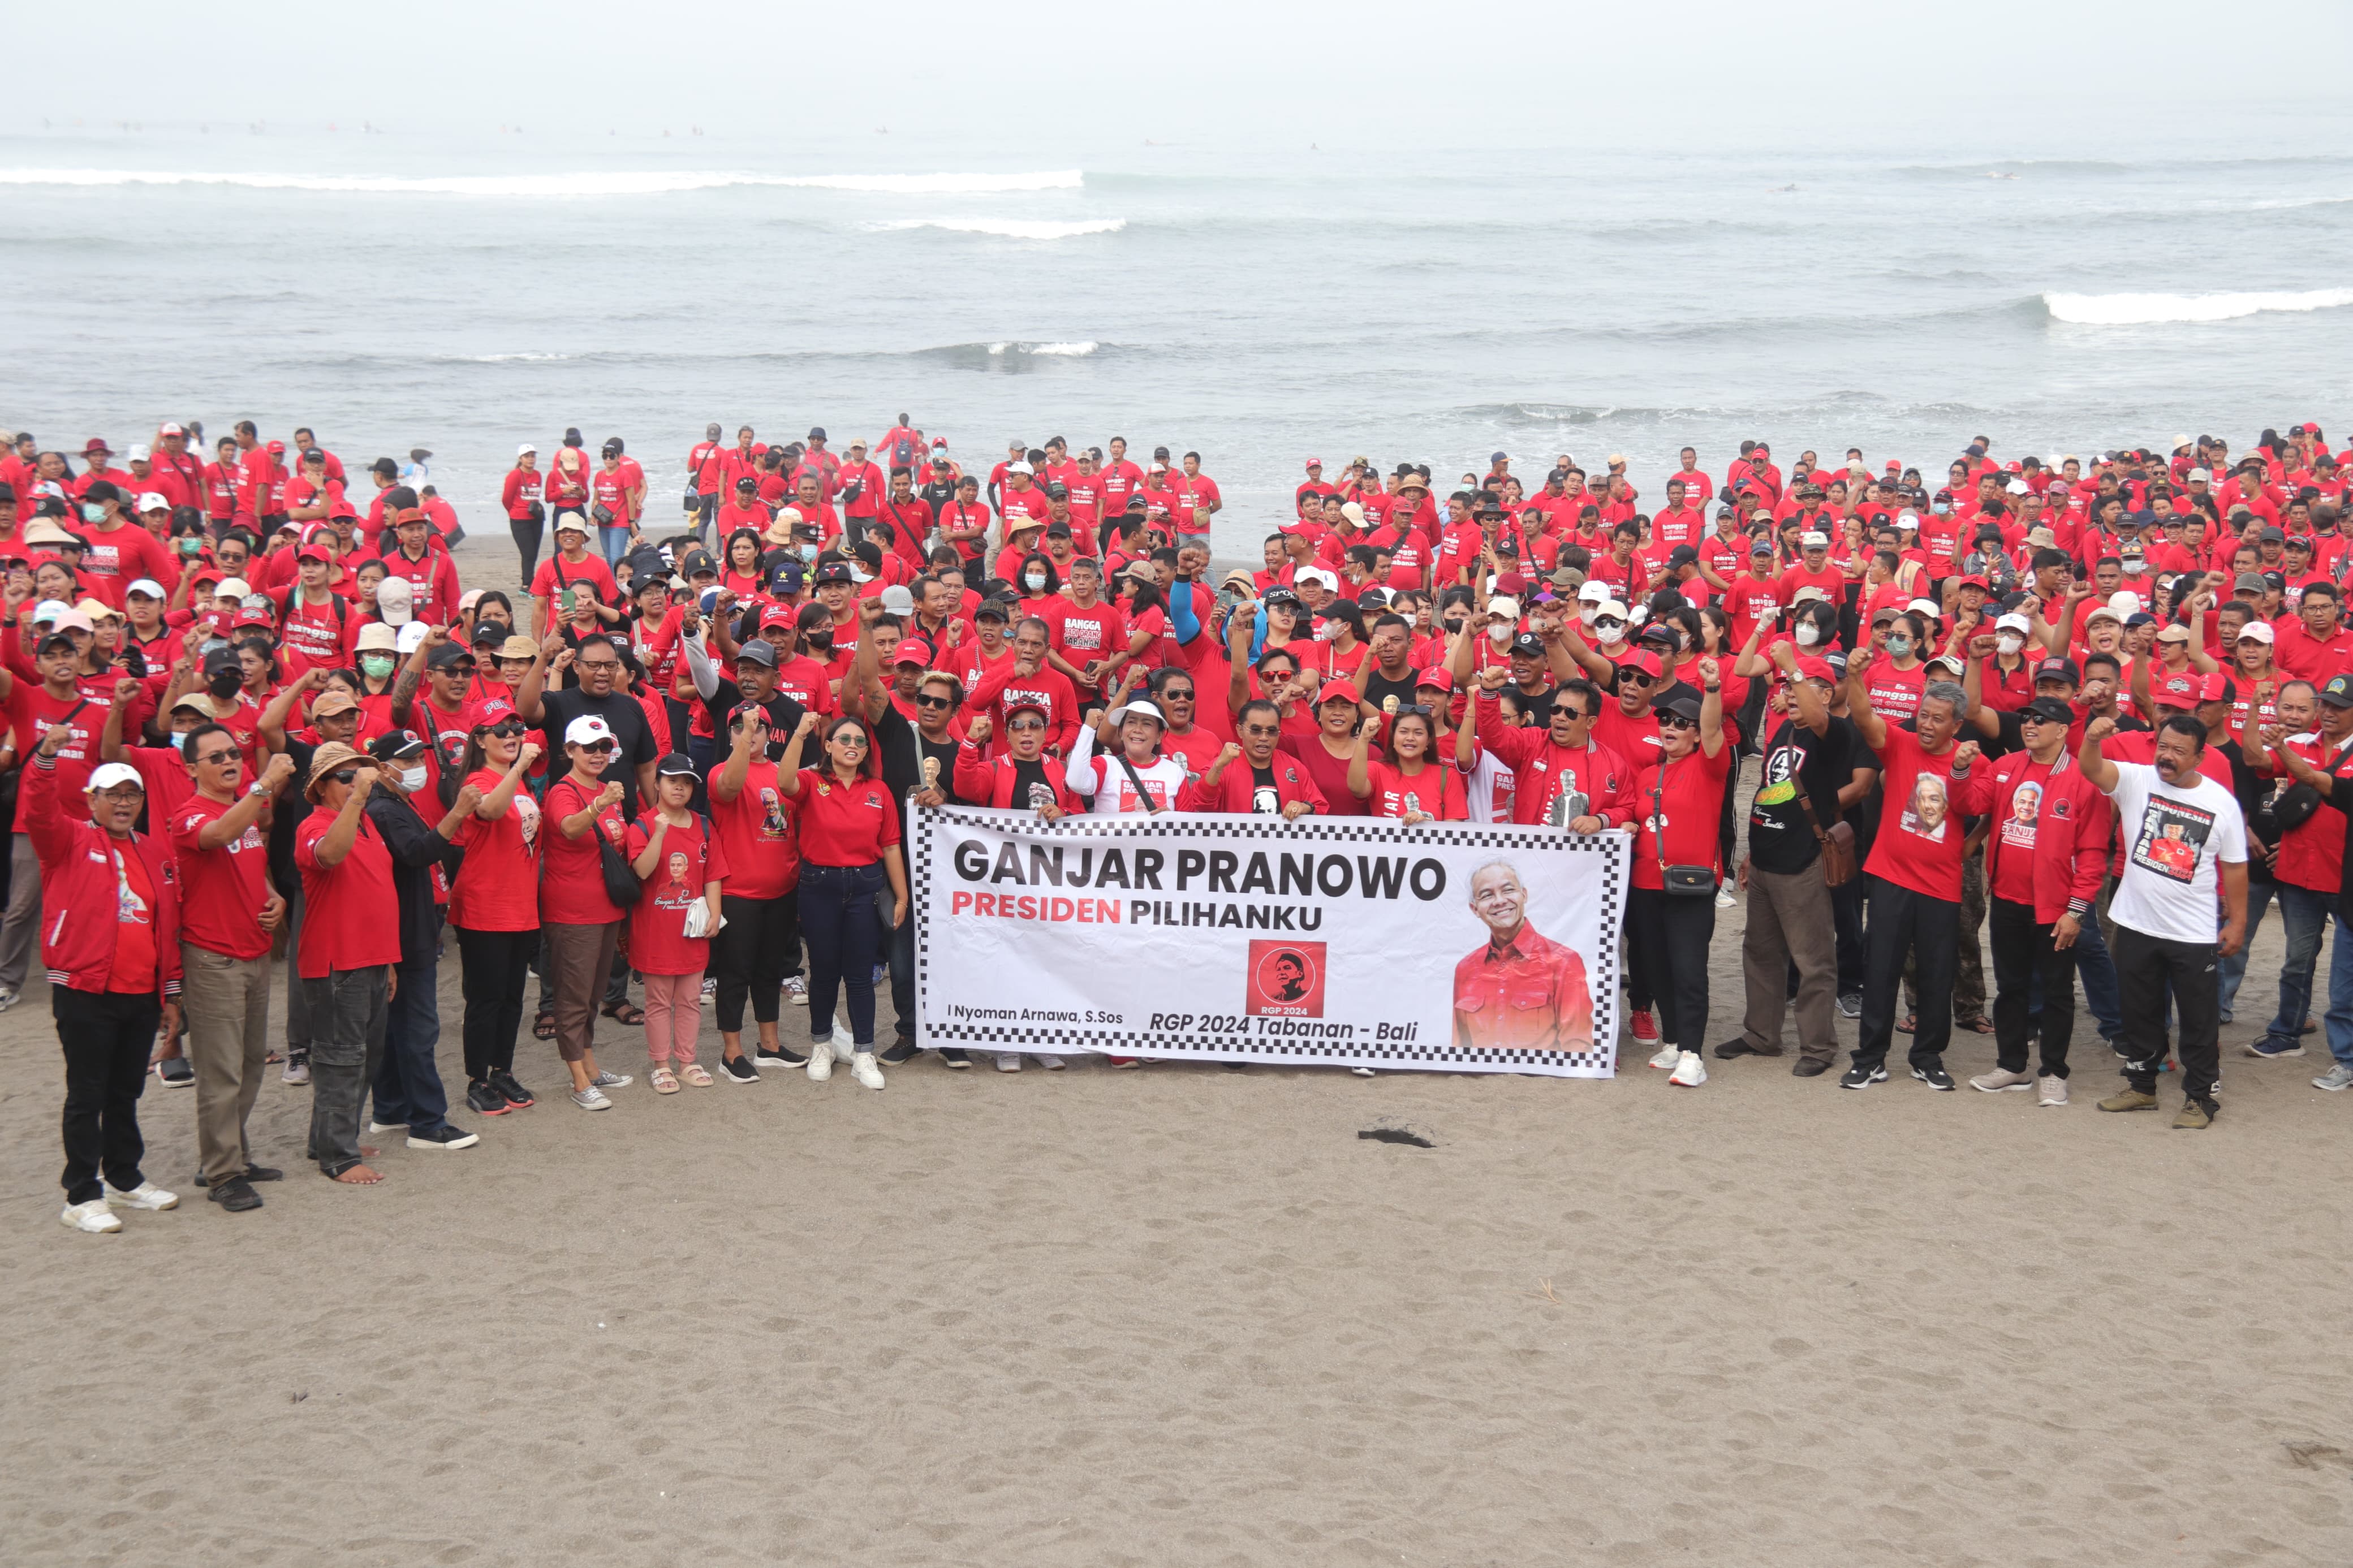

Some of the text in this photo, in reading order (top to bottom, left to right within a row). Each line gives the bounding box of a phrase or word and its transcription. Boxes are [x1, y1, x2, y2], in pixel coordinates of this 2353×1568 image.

[1749, 597, 1776, 607] bangga
[286, 622, 337, 640] bangga
[1065, 618, 1101, 631] BANGGA
[1064, 637, 1100, 649] TABANAN
[1080, 630, 1101, 639] ORANG
[1869, 687, 1917, 701] bangga
[1885, 700, 1916, 710] orang
[2148, 797, 2212, 826] INDONESIA
[2135, 809, 2158, 856] GANJAR
[954, 839, 1446, 901] GANJAR PRANOWO
[2133, 852, 2194, 881] PRESIDEN 2024
[952, 891, 1322, 931] PRESIDEN PILIHANKU
[954, 1005, 1017, 1022] Nyoman
[1020, 1008, 1081, 1025] Arnawa,
[1085, 1010, 1123, 1025] S.Sos
[1261, 1007, 1308, 1016] RGP 2024
[1149, 1013, 1193, 1031] RGP
[1197, 1014, 1250, 1034] 2024
[1257, 1017, 1354, 1039] Tabanan
[1376, 1021, 1419, 1041] Bali
